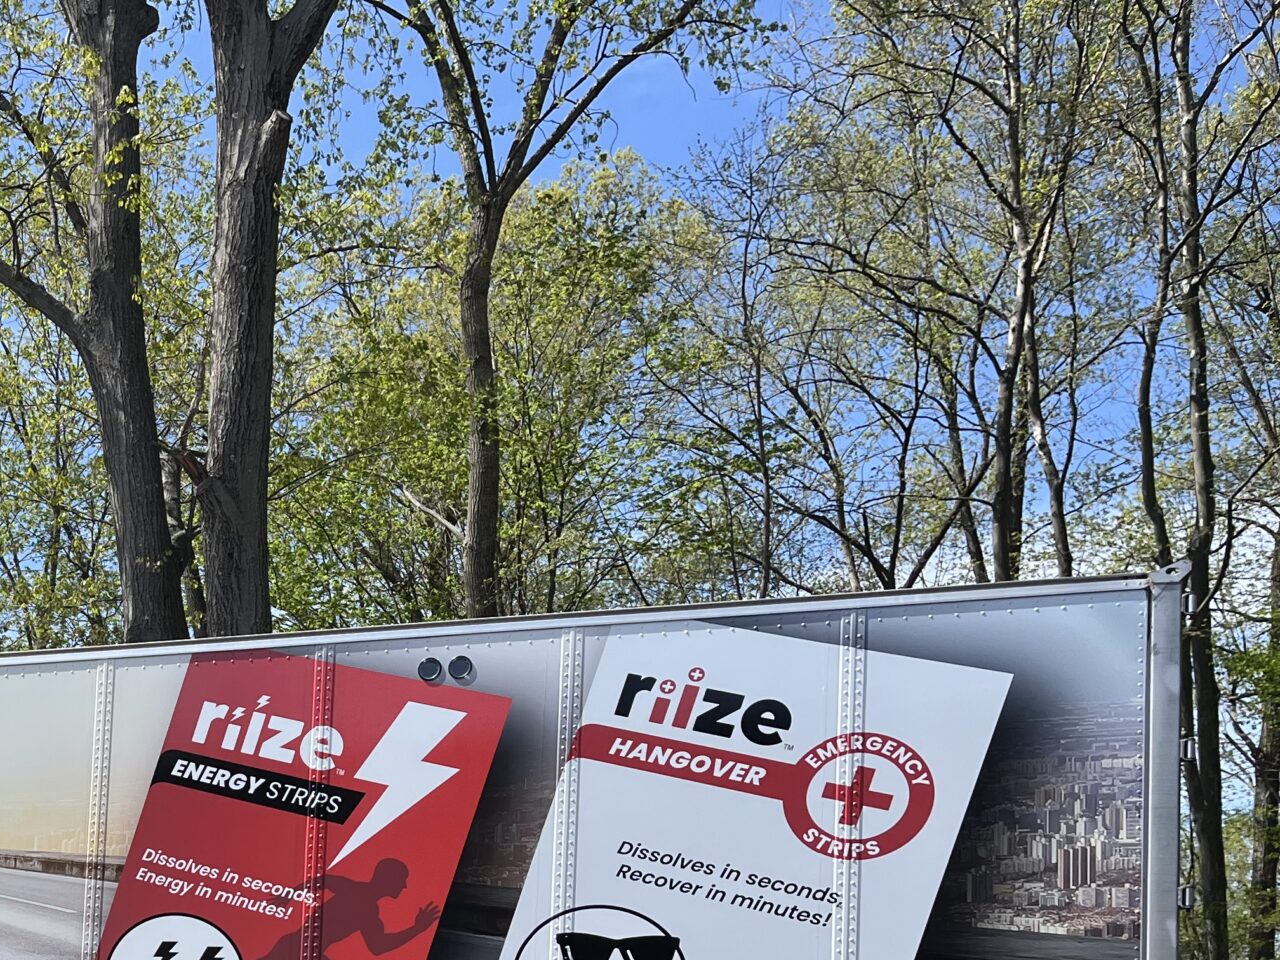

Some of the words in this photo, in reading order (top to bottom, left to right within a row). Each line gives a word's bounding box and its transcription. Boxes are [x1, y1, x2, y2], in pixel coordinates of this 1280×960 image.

[191, 694, 344, 771] riize
[614, 667, 792, 746] riize
[170, 758, 268, 796] ENERGY
[266, 781, 343, 814] STRIPS
[608, 738, 767, 786] HANGOVER
[804, 734, 930, 788] EMERGENCY
[803, 828, 880, 858] STRIPS
[135, 867, 194, 899] Energy
[195, 881, 212, 900] in
[214, 889, 294, 920] minutes!
[141, 848, 220, 881] Dissolves
[222, 867, 239, 885] in
[241, 873, 319, 907] seconds,
[616, 841, 716, 877] Dissolves
[720, 863, 742, 882] in
[746, 872, 844, 909] seconds,
[616, 864, 704, 899] Recover
[706, 884, 727, 903] in
[730, 891, 834, 928] minutes!
